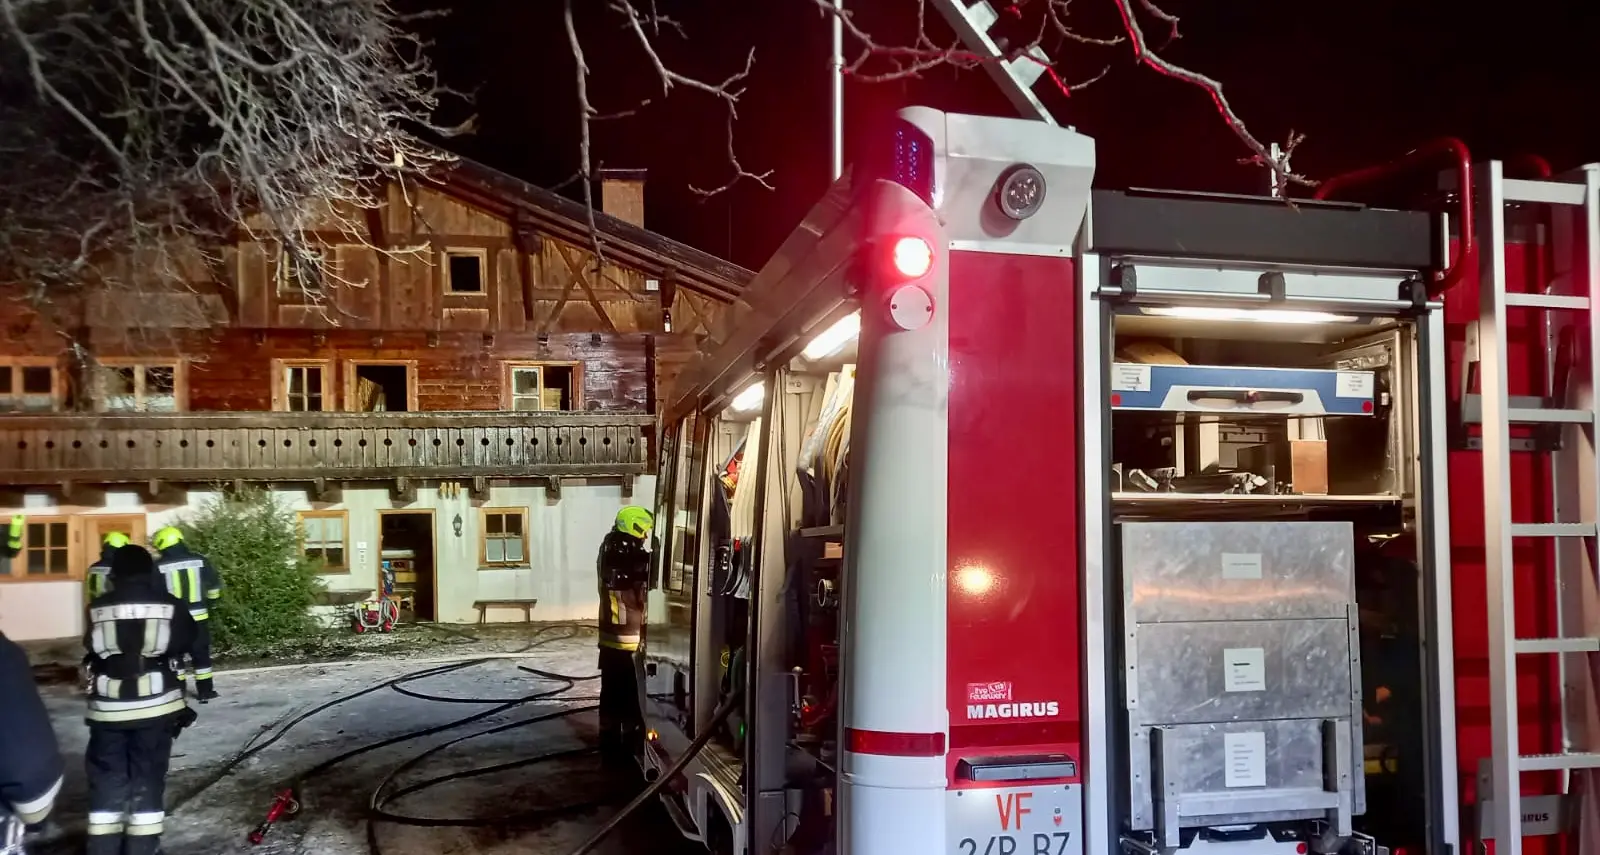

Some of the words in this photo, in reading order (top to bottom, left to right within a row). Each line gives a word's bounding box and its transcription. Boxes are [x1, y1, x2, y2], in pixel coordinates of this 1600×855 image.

[967, 702, 1059, 719] MAGIRUS
[995, 792, 1033, 831] VF
[1520, 813, 1549, 823] IRUS
